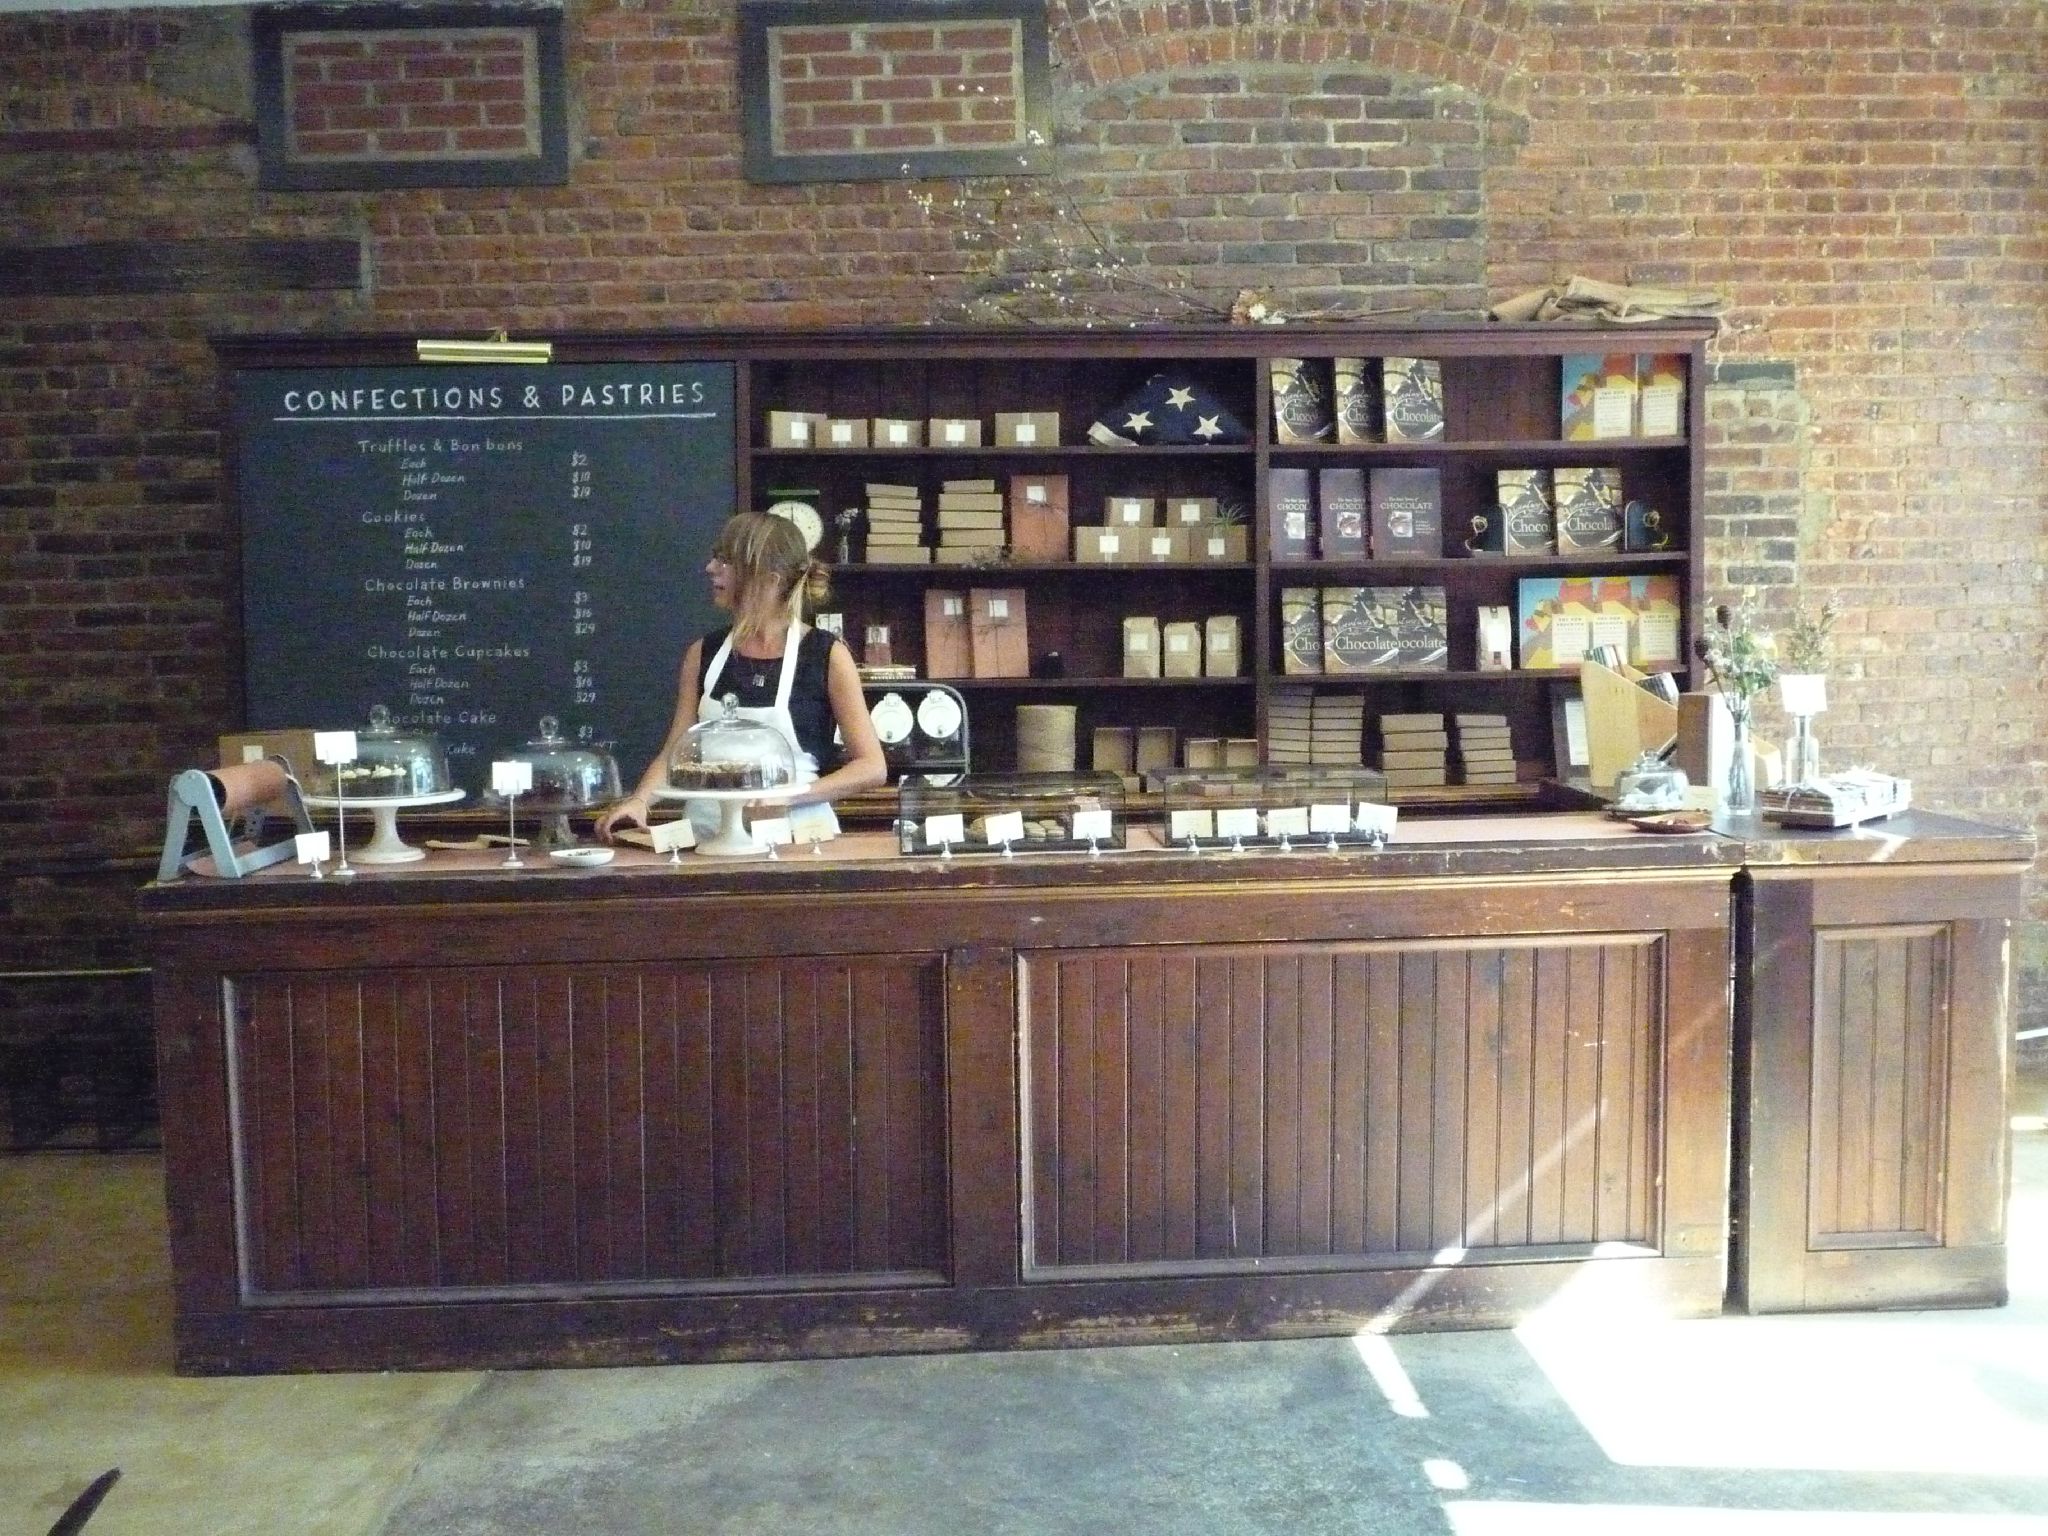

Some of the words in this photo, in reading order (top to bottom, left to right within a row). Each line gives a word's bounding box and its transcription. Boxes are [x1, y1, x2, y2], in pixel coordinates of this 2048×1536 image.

[284, 387, 503, 411] CONFECTIONS
[523, 385, 541, 408] &
[562, 382, 704, 406] PASTRIES
[1394, 407, 1443, 424] Chocolate
[358, 438, 426, 453] Truffles
[434, 438, 442, 451] &
[400, 457, 427, 470] Each
[572, 450, 588, 466] $2
[402, 473, 428, 486] Half
[432, 472, 465, 483] Dozen
[404, 489, 437, 500] Dozen
[1380, 502, 1433, 510] CHOCOLATE
[362, 509, 426, 523] Cookies
[404, 527, 433, 538] Each
[572, 524, 588, 536] $2
[405, 541, 429, 554] Half
[431, 541, 464, 553] Dozen
[405, 559, 437, 570] Dozen
[573, 554, 592, 567] $19
[365, 578, 446, 592] Chocolate
[453, 576, 526, 590] Brownies
[406, 595, 432, 607] Each
[408, 610, 432, 622] Half
[432, 610, 467, 622] Dozen
[408, 627, 441, 638] Dozen
[575, 622, 596, 635] $29
[1335, 636, 1399, 651] Chocolate
[1399, 635, 1447, 650] ocolate
[367, 645, 448, 659] Chocolate
[455, 644, 530, 661] Cupcakes
[409, 663, 436, 675] Each
[573, 660, 588, 673] $3
[410, 678, 433, 690] Half
[434, 678, 469, 690] Dozen
[576, 692, 596, 704] $29
[459, 710, 497, 724] Cake
